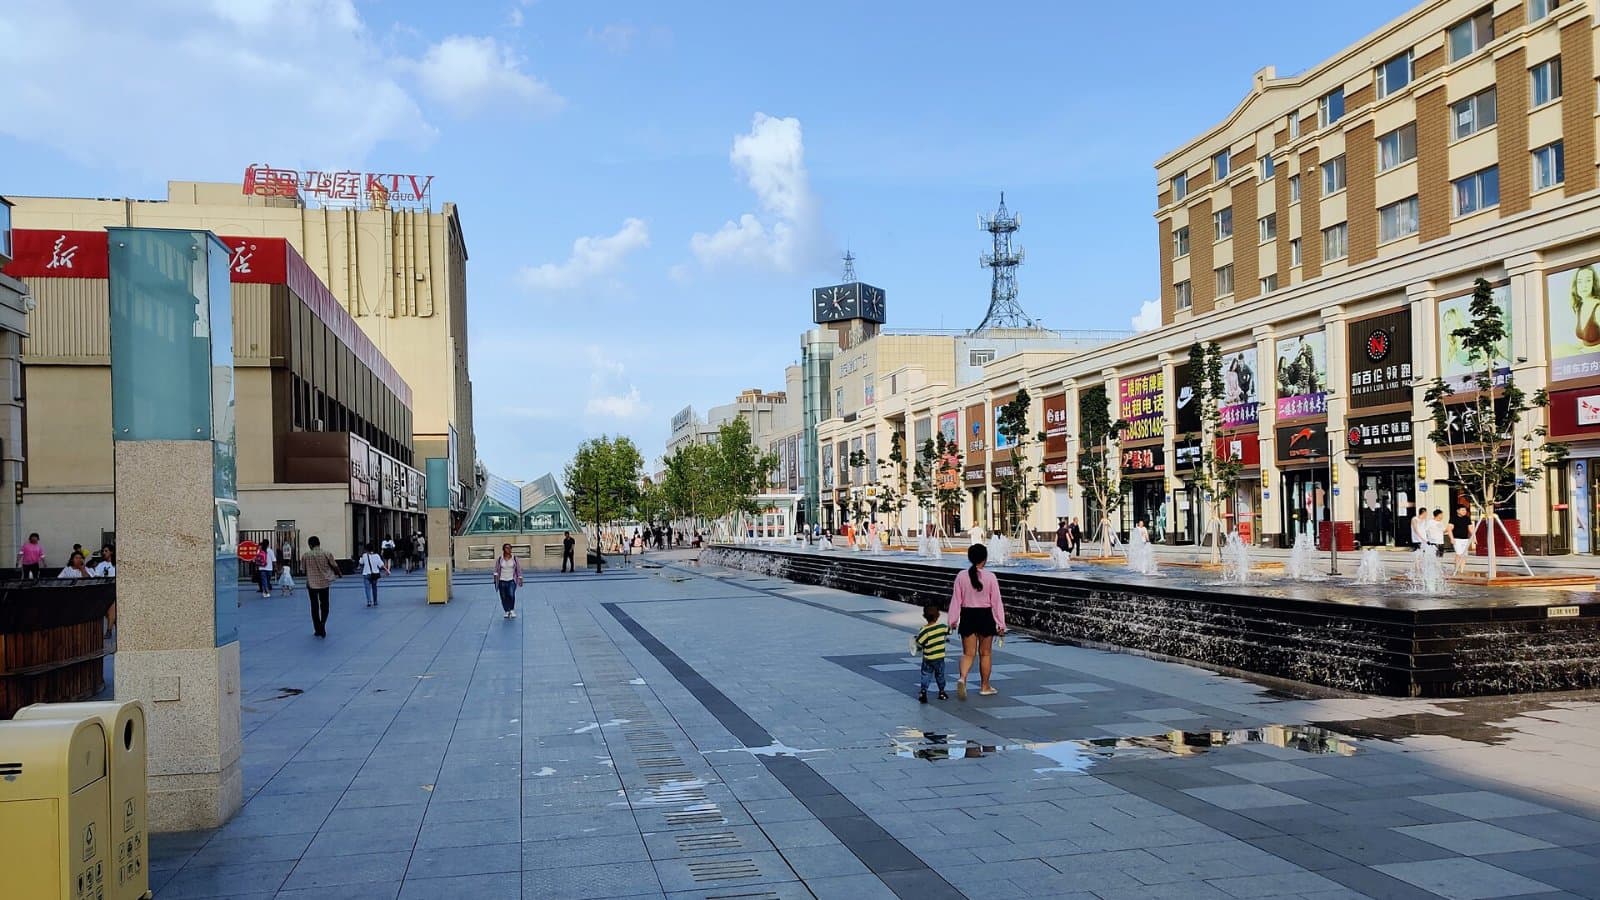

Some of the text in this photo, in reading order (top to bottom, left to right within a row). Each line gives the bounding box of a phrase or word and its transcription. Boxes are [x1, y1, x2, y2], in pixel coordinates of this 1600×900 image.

[365, 173, 435, 201] KTV
[46, 234, 79, 269] 新
[1122, 393, 1164, 418] 出租电话
